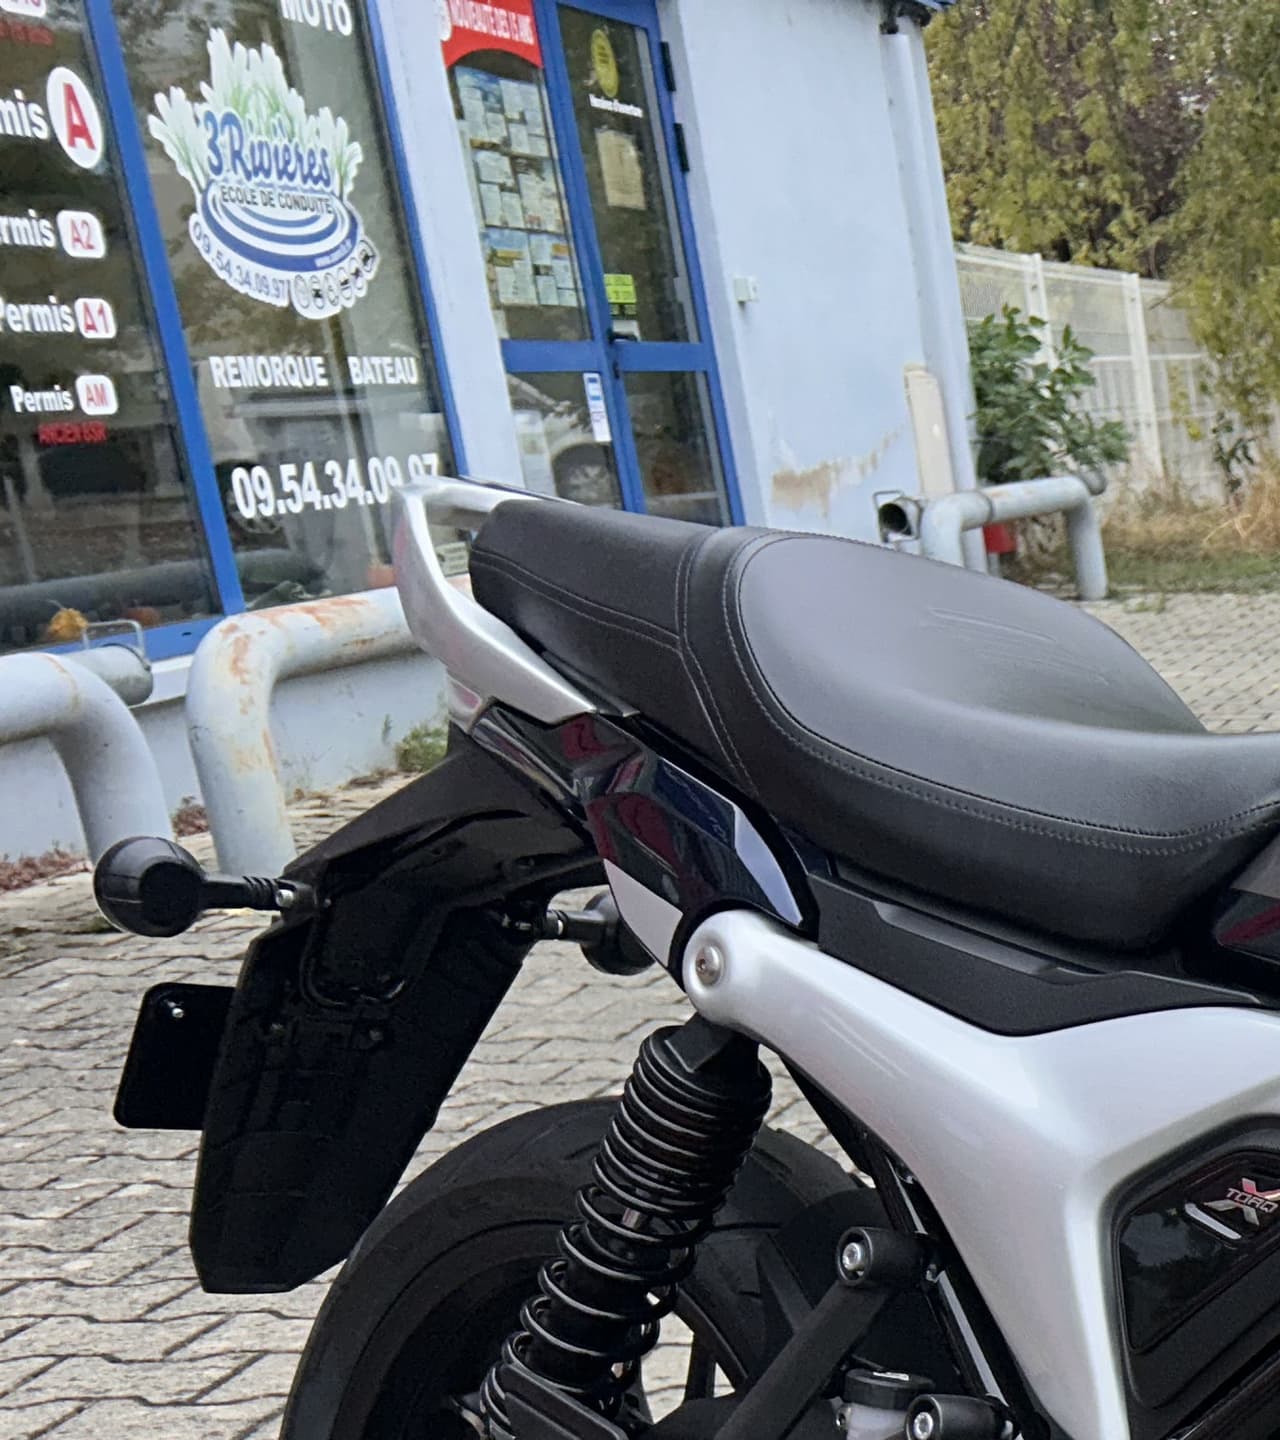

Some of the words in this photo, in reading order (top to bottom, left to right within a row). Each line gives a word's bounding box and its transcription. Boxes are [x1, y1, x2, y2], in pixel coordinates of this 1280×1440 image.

[0, 89, 48, 139] mis
[63, 83, 96, 150] A
[204, 111, 223, 176] 3
[220, 184, 258, 206] ECOLE
[262, 189, 276, 208] DE
[278, 191, 334, 215] CONDUITE
[0, 208, 56, 248] rmis
[69, 217, 96, 251] A2
[82, 300, 109, 334] A1
[208, 355, 329, 388] REMORQUE
[347, 356, 419, 385] BATEAU
[9, 384, 75, 413] Permis
[85, 383, 109, 408] AM
[1226, 1187, 1279, 1214] TORQ
